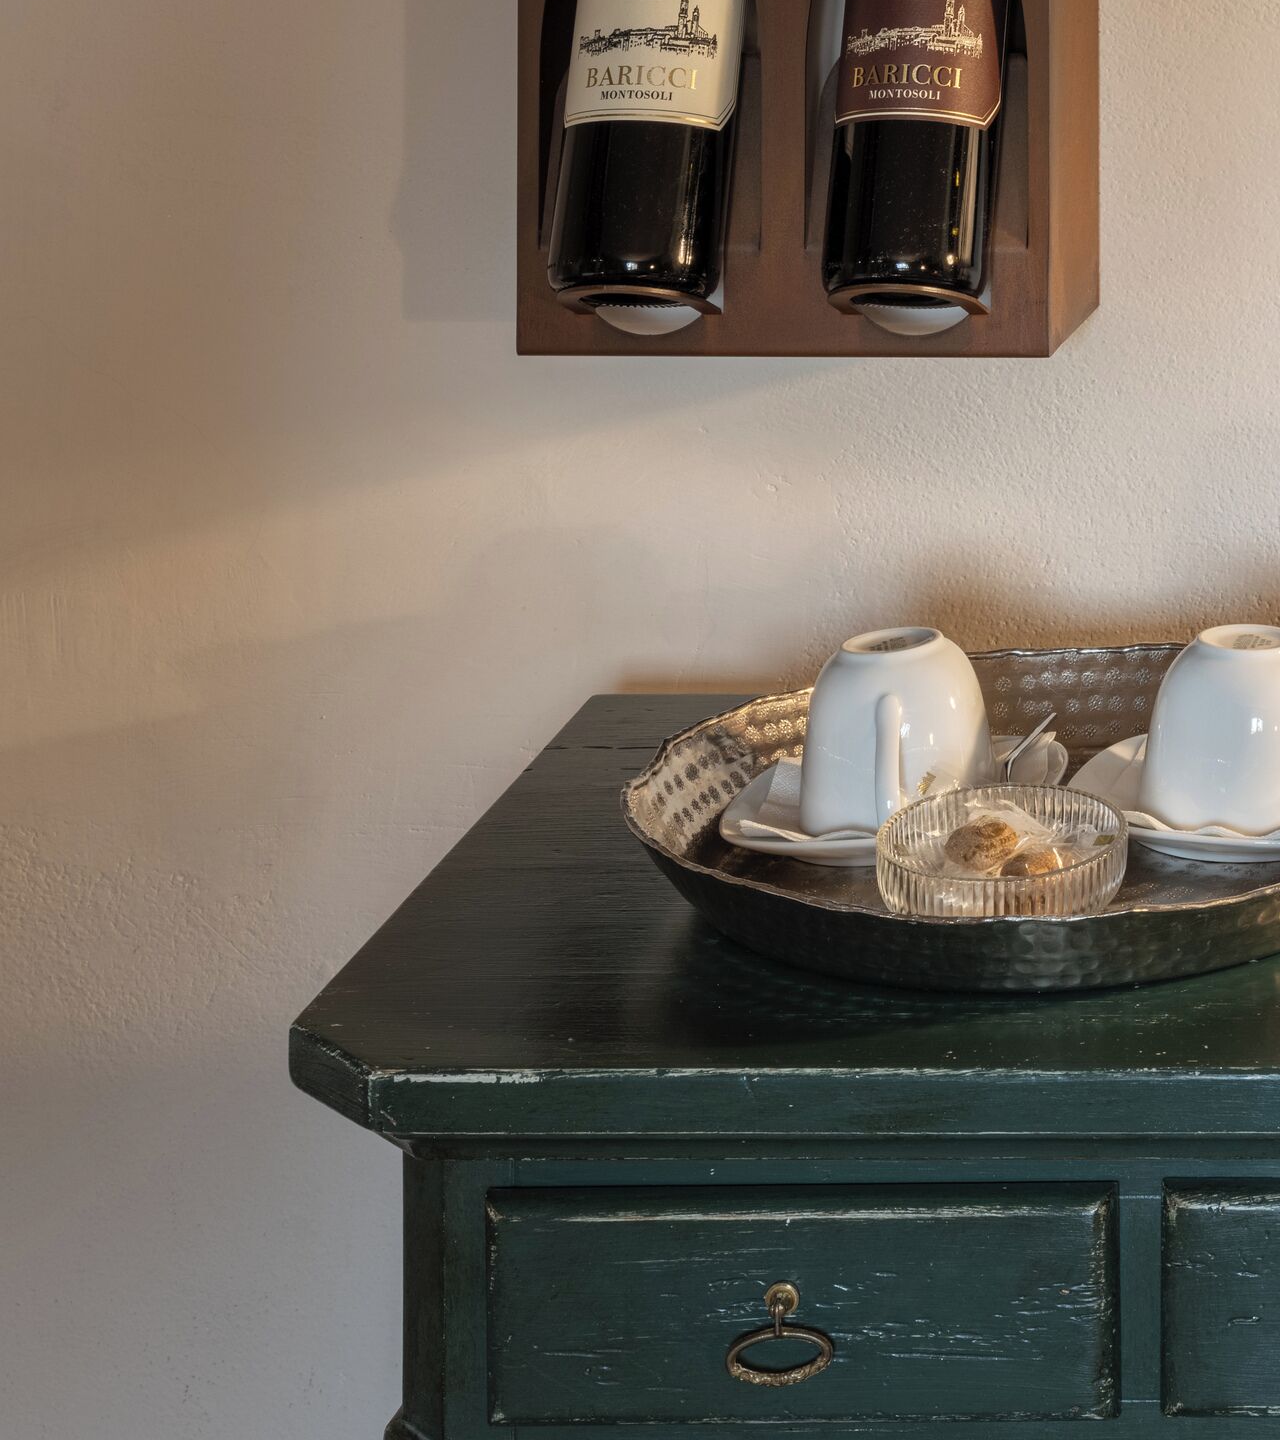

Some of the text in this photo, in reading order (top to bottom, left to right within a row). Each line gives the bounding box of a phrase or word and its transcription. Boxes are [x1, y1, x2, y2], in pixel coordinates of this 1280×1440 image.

[586, 65, 697, 90] BARICCI
[852, 63, 962, 89] BARICCI
[600, 89, 673, 101] MONTOSOLI
[868, 88, 941, 100] MONTOSOLI
